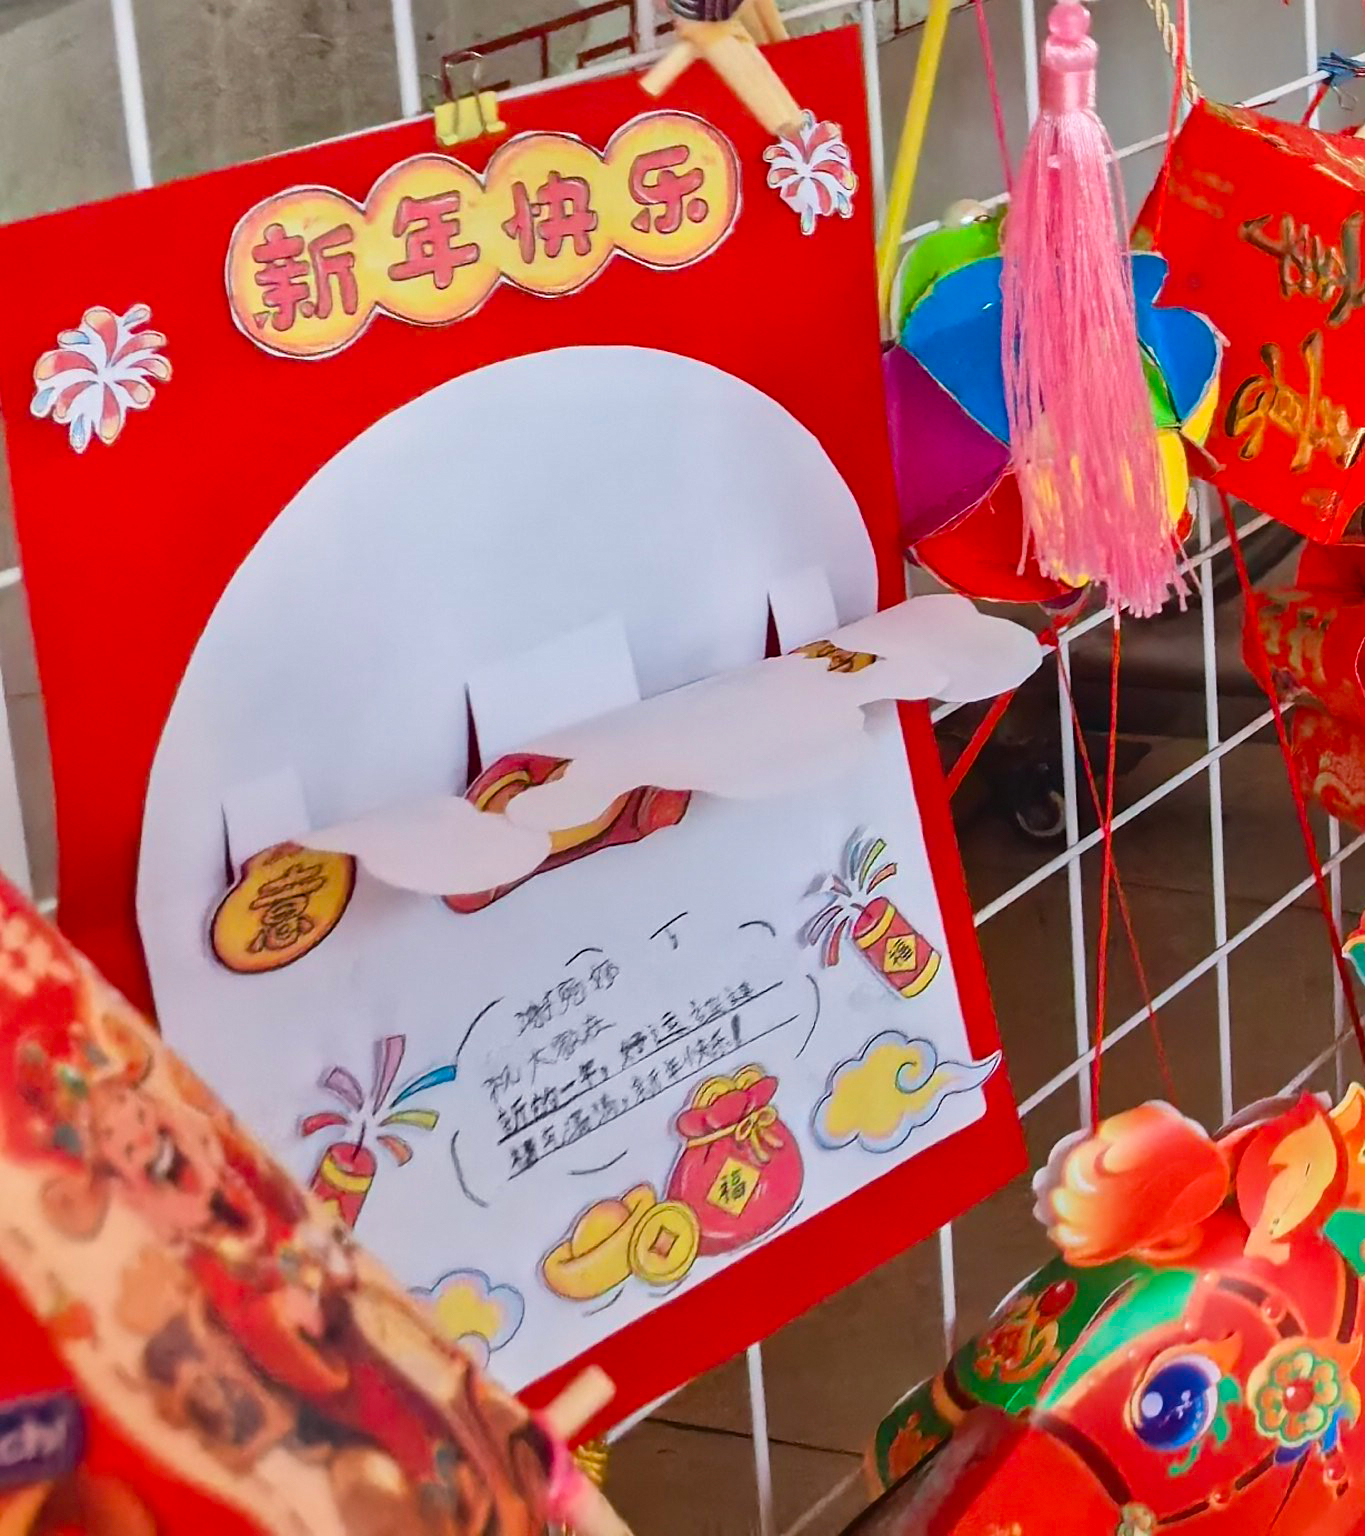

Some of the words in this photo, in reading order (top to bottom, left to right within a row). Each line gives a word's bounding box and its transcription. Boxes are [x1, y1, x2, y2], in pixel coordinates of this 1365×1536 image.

[254, 144, 710, 332] 新年快乐
[718, 1168, 747, 1202] 福
